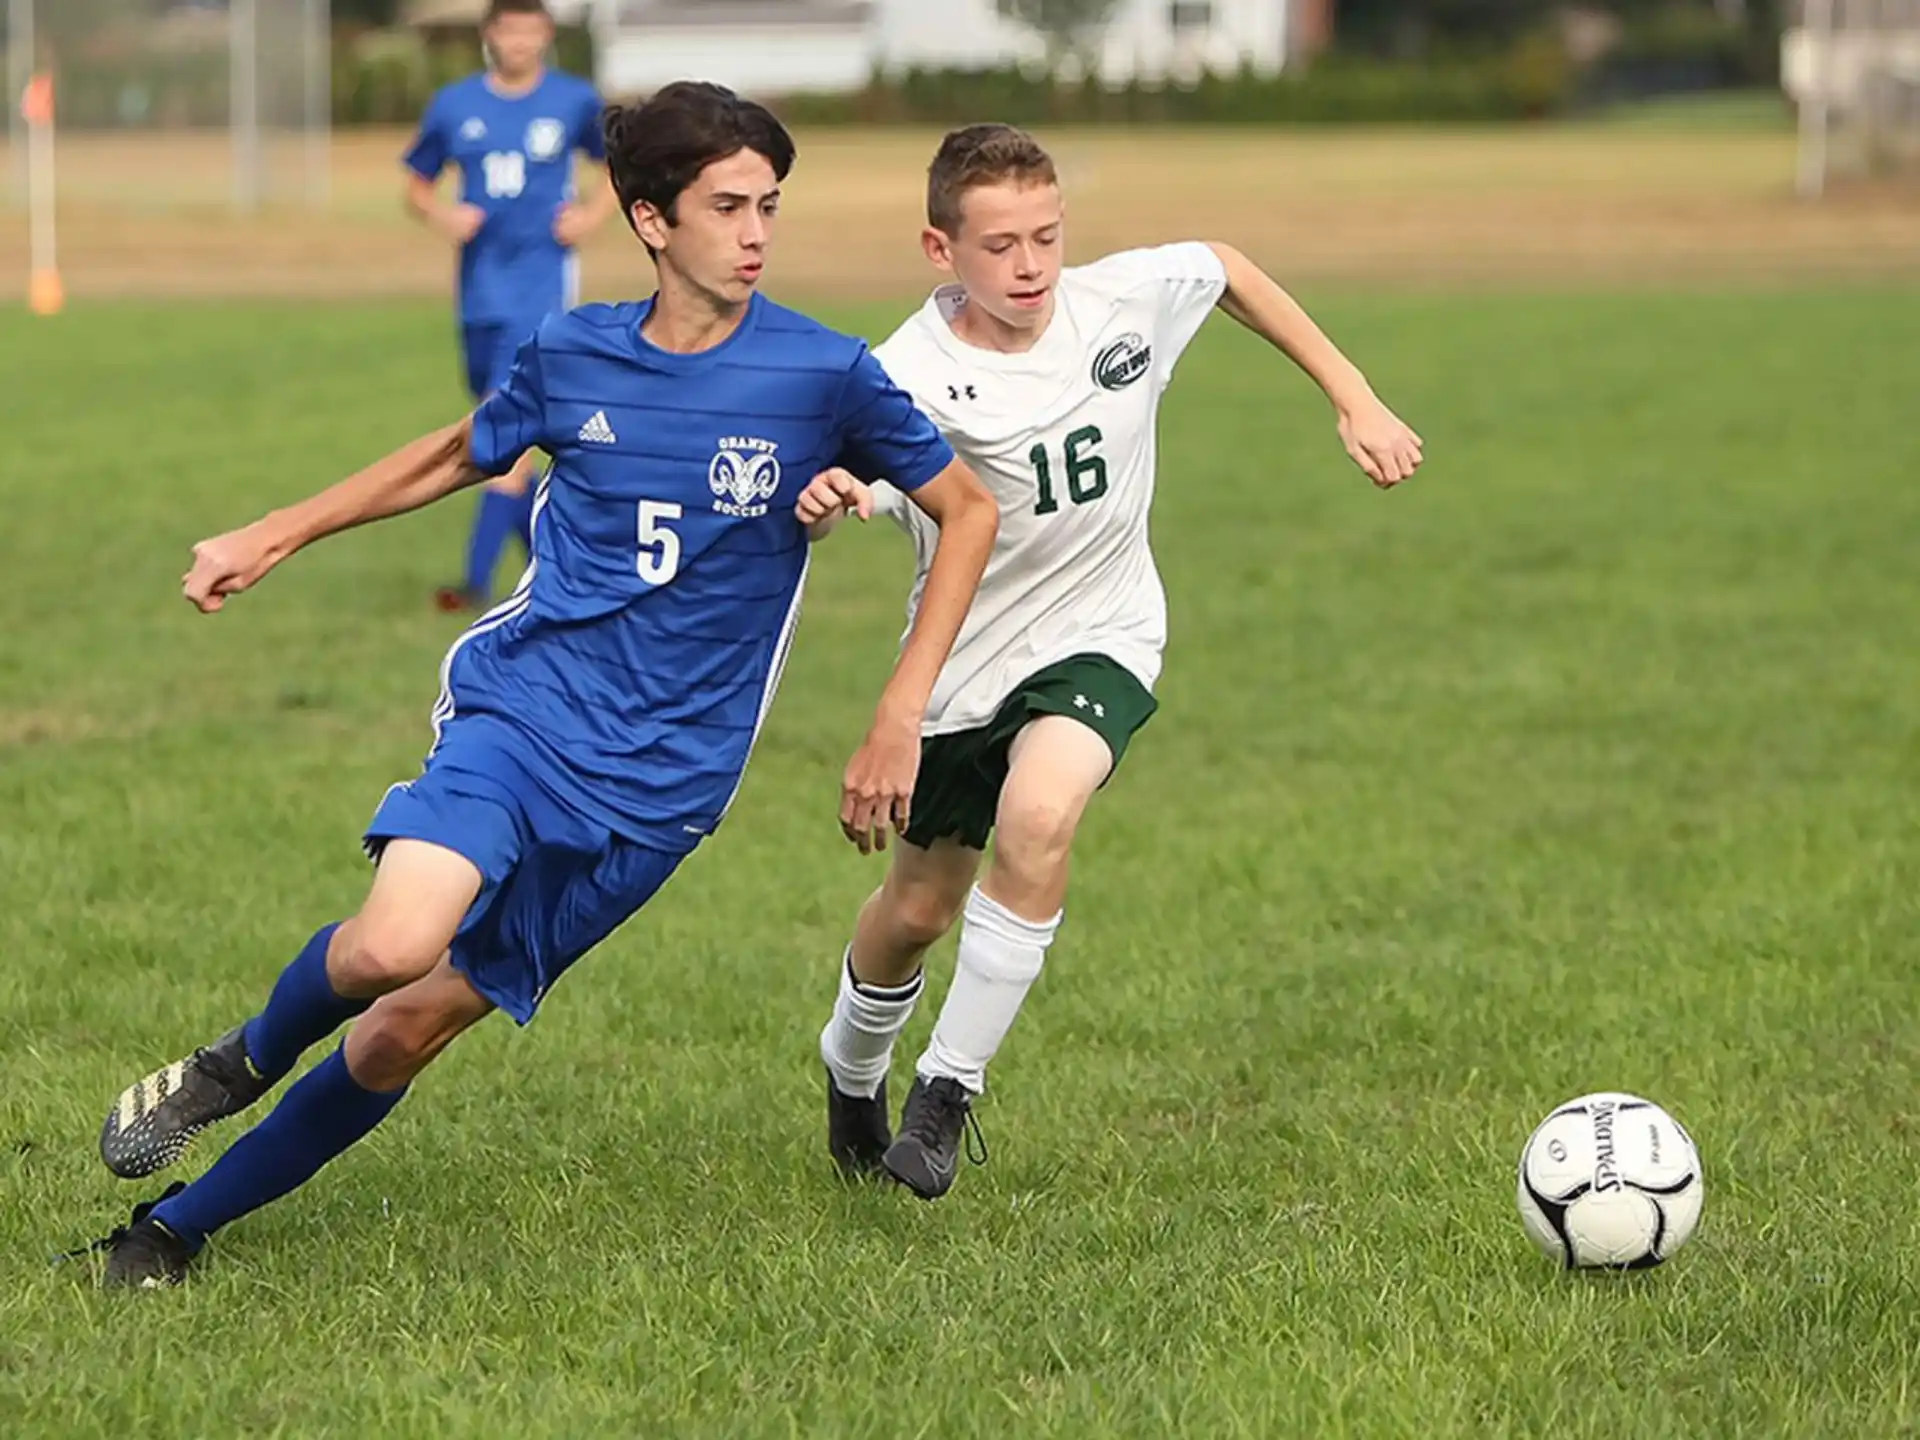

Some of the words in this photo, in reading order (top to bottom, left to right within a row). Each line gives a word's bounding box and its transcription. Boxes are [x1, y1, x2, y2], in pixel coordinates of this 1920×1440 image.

[712, 499, 768, 518] SOCCER
[1029, 424, 1109, 515] 16
[636, 499, 683, 586] 5
[1590, 1101, 1621, 1193] SPALDING
